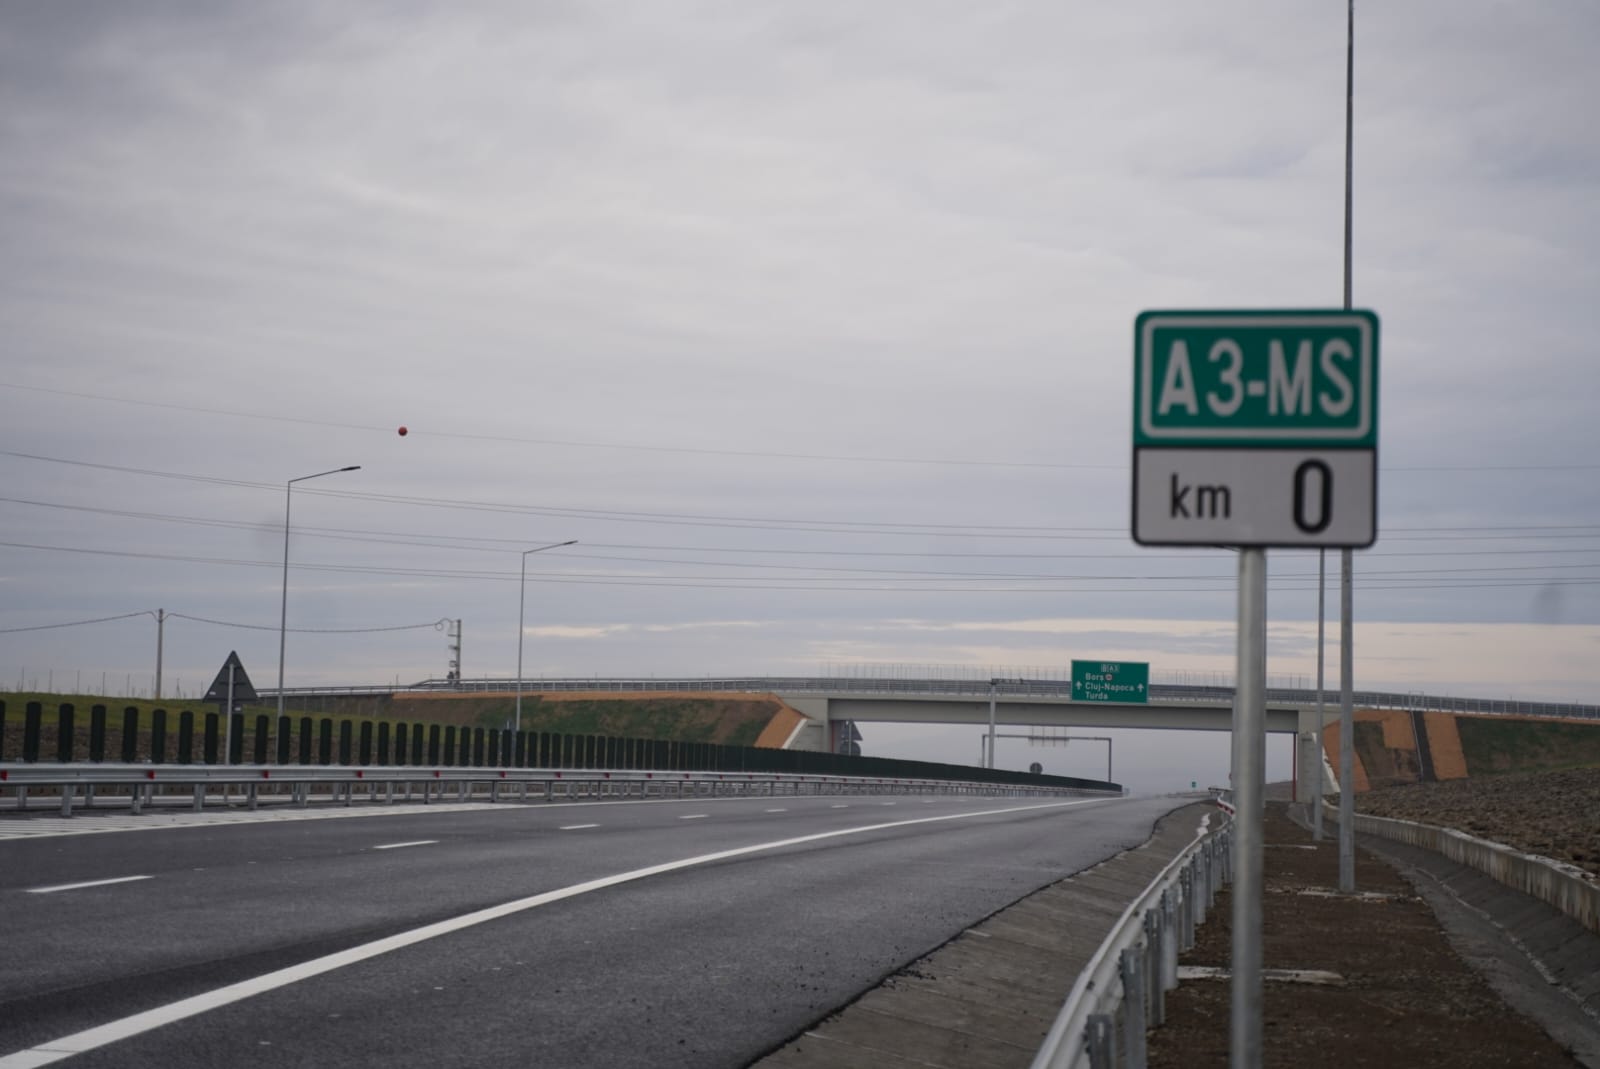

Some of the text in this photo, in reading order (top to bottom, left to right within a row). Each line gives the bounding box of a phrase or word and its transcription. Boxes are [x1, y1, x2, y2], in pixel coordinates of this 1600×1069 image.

[1169, 457, 1334, 536] km 0
[1085, 682, 1135, 693] Cluj-Napoca
[1085, 692, 1109, 700] Turda
